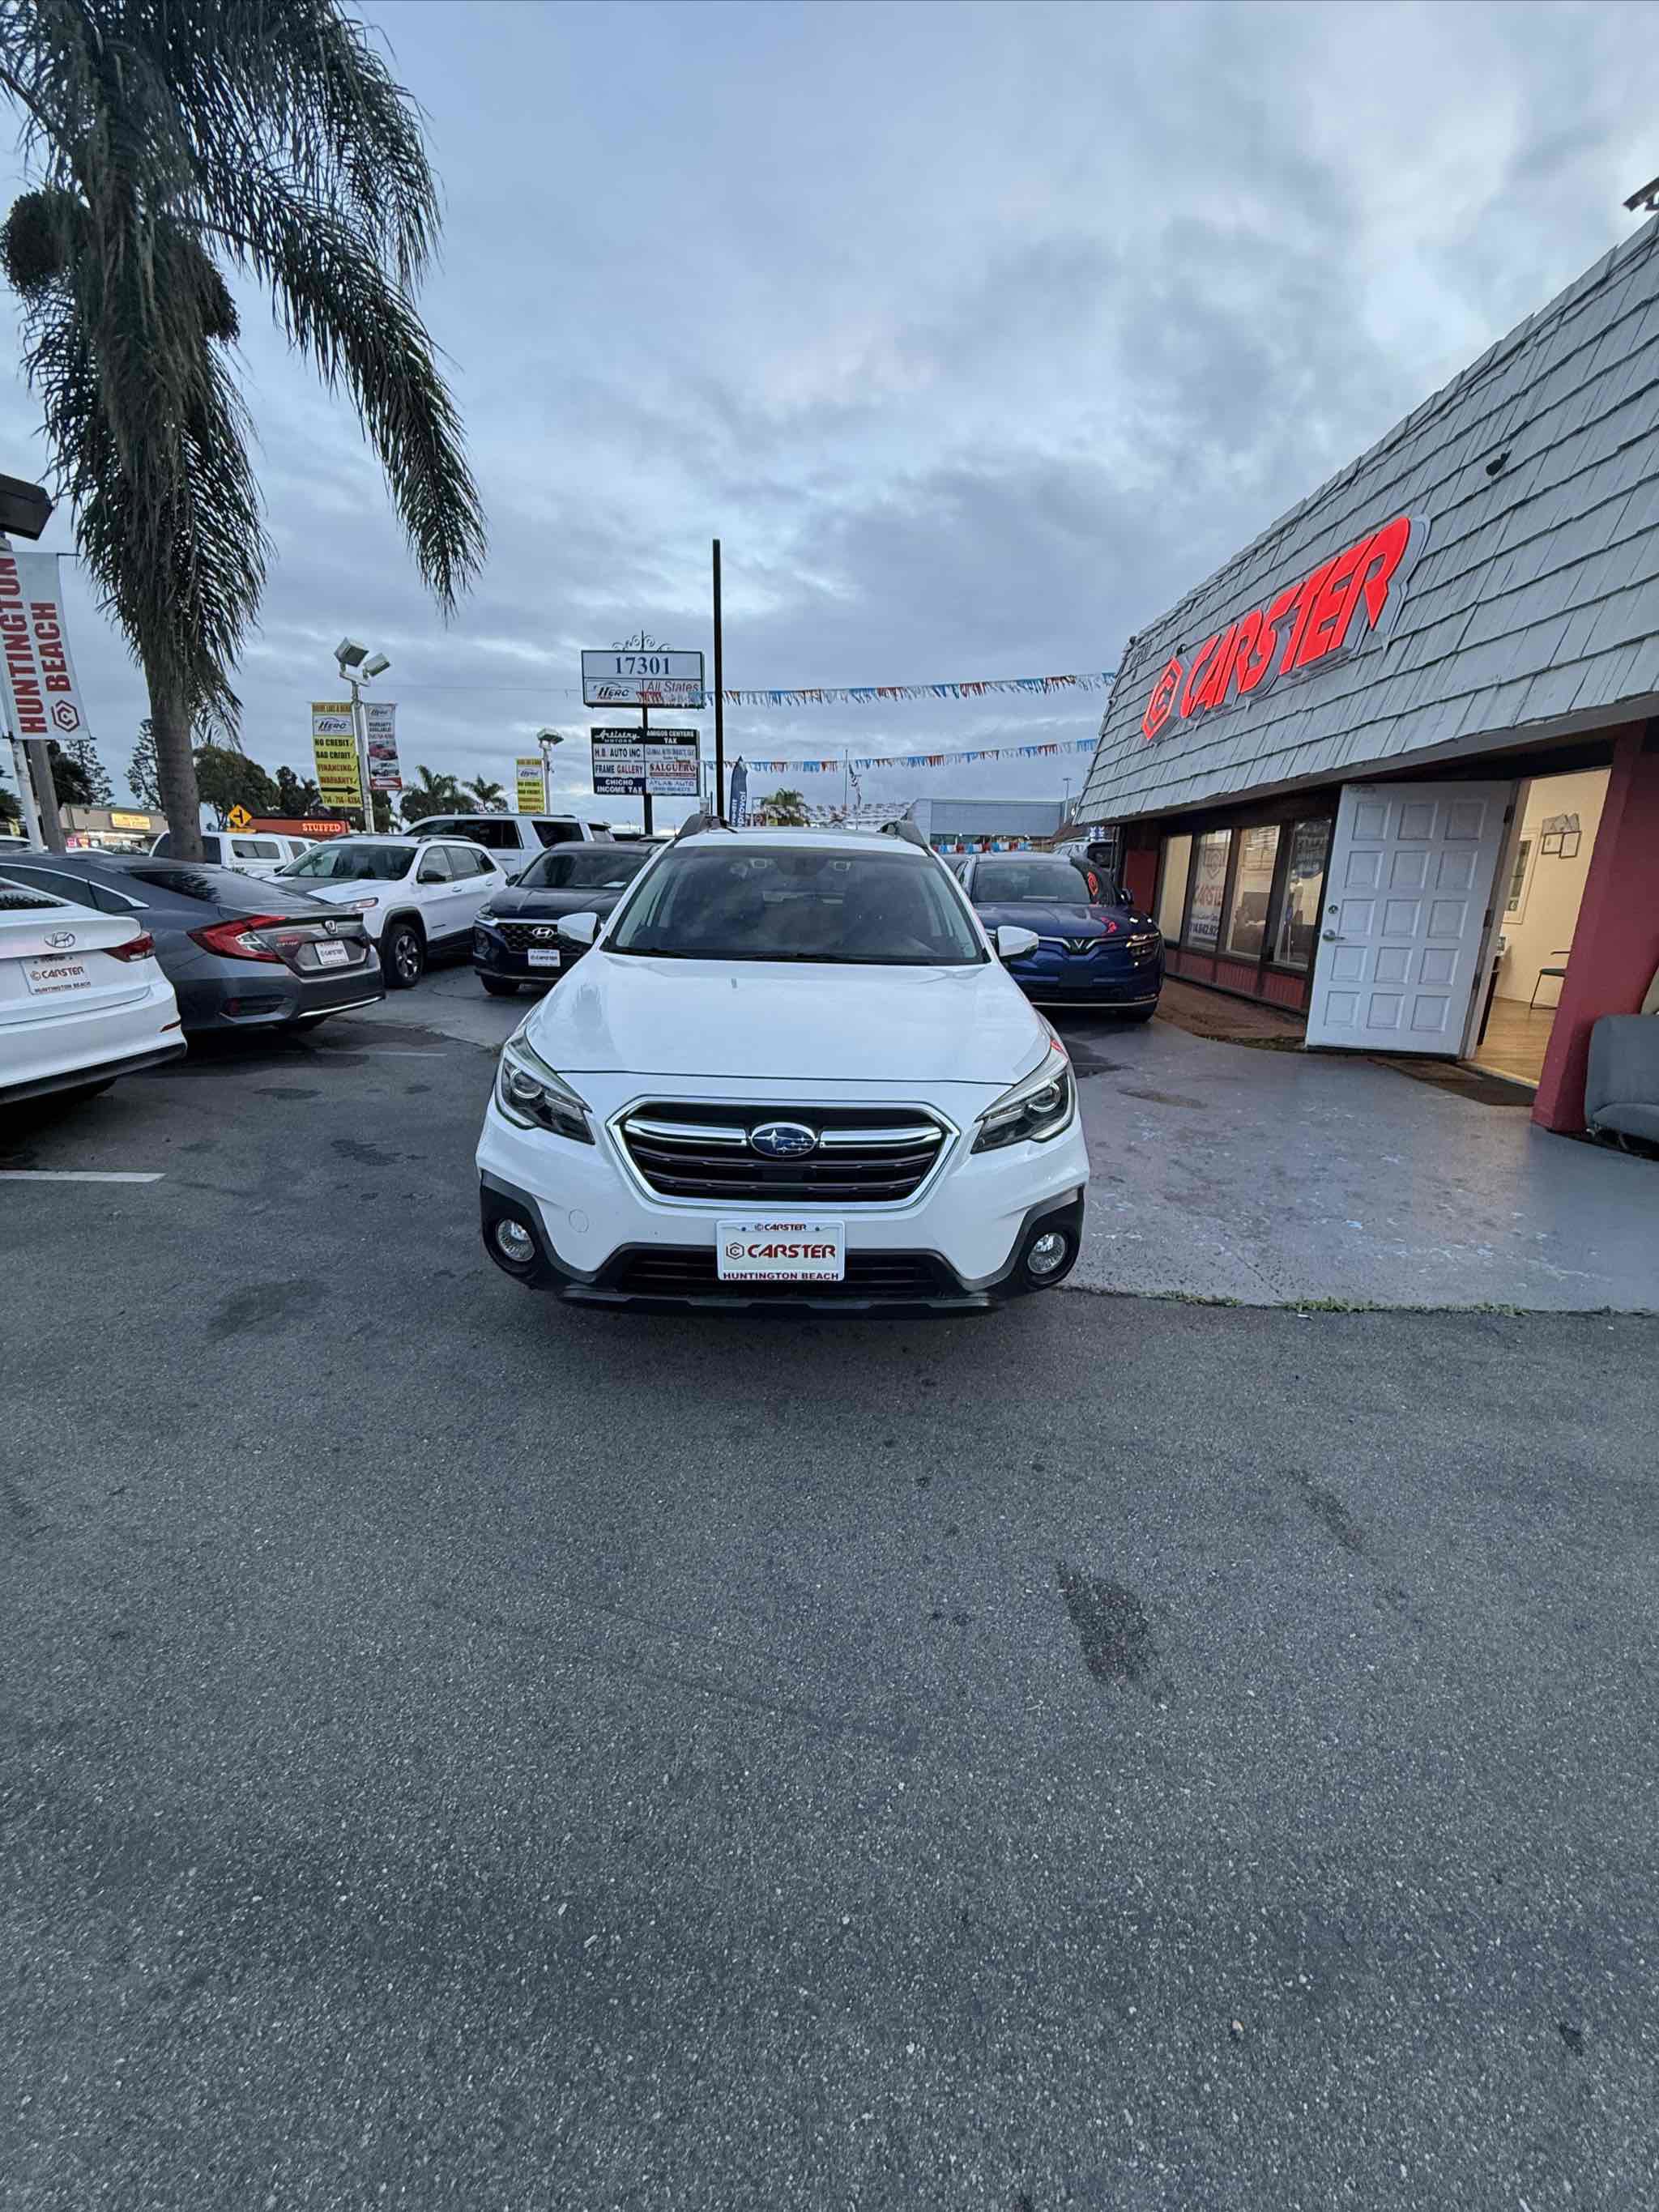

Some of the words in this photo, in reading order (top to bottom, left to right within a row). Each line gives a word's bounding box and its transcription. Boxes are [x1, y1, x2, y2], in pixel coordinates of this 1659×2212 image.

[1179, 515, 1411, 719] CARSTER
[0, 557, 48, 733] HUNTINGTON
[30, 602, 72, 692] BEACH
[616, 656, 671, 675] 17301
[647, 680, 661, 692] All
[663, 680, 699, 693] States
[325, 739, 349, 747] CREDIT
[330, 751, 350, 759] CREDIT
[610, 748, 628, 757] AUTO
[629, 748, 642, 757] INC
[595, 765, 615, 774] FRAME
[617, 765, 643, 774] GALLERY
[650, 764, 695, 772] SALGUERO
[302, 822, 341, 832] STUFFED
[764, 1223, 807, 1231] CARSTER
[747, 1243, 836, 1259] CARSTER
